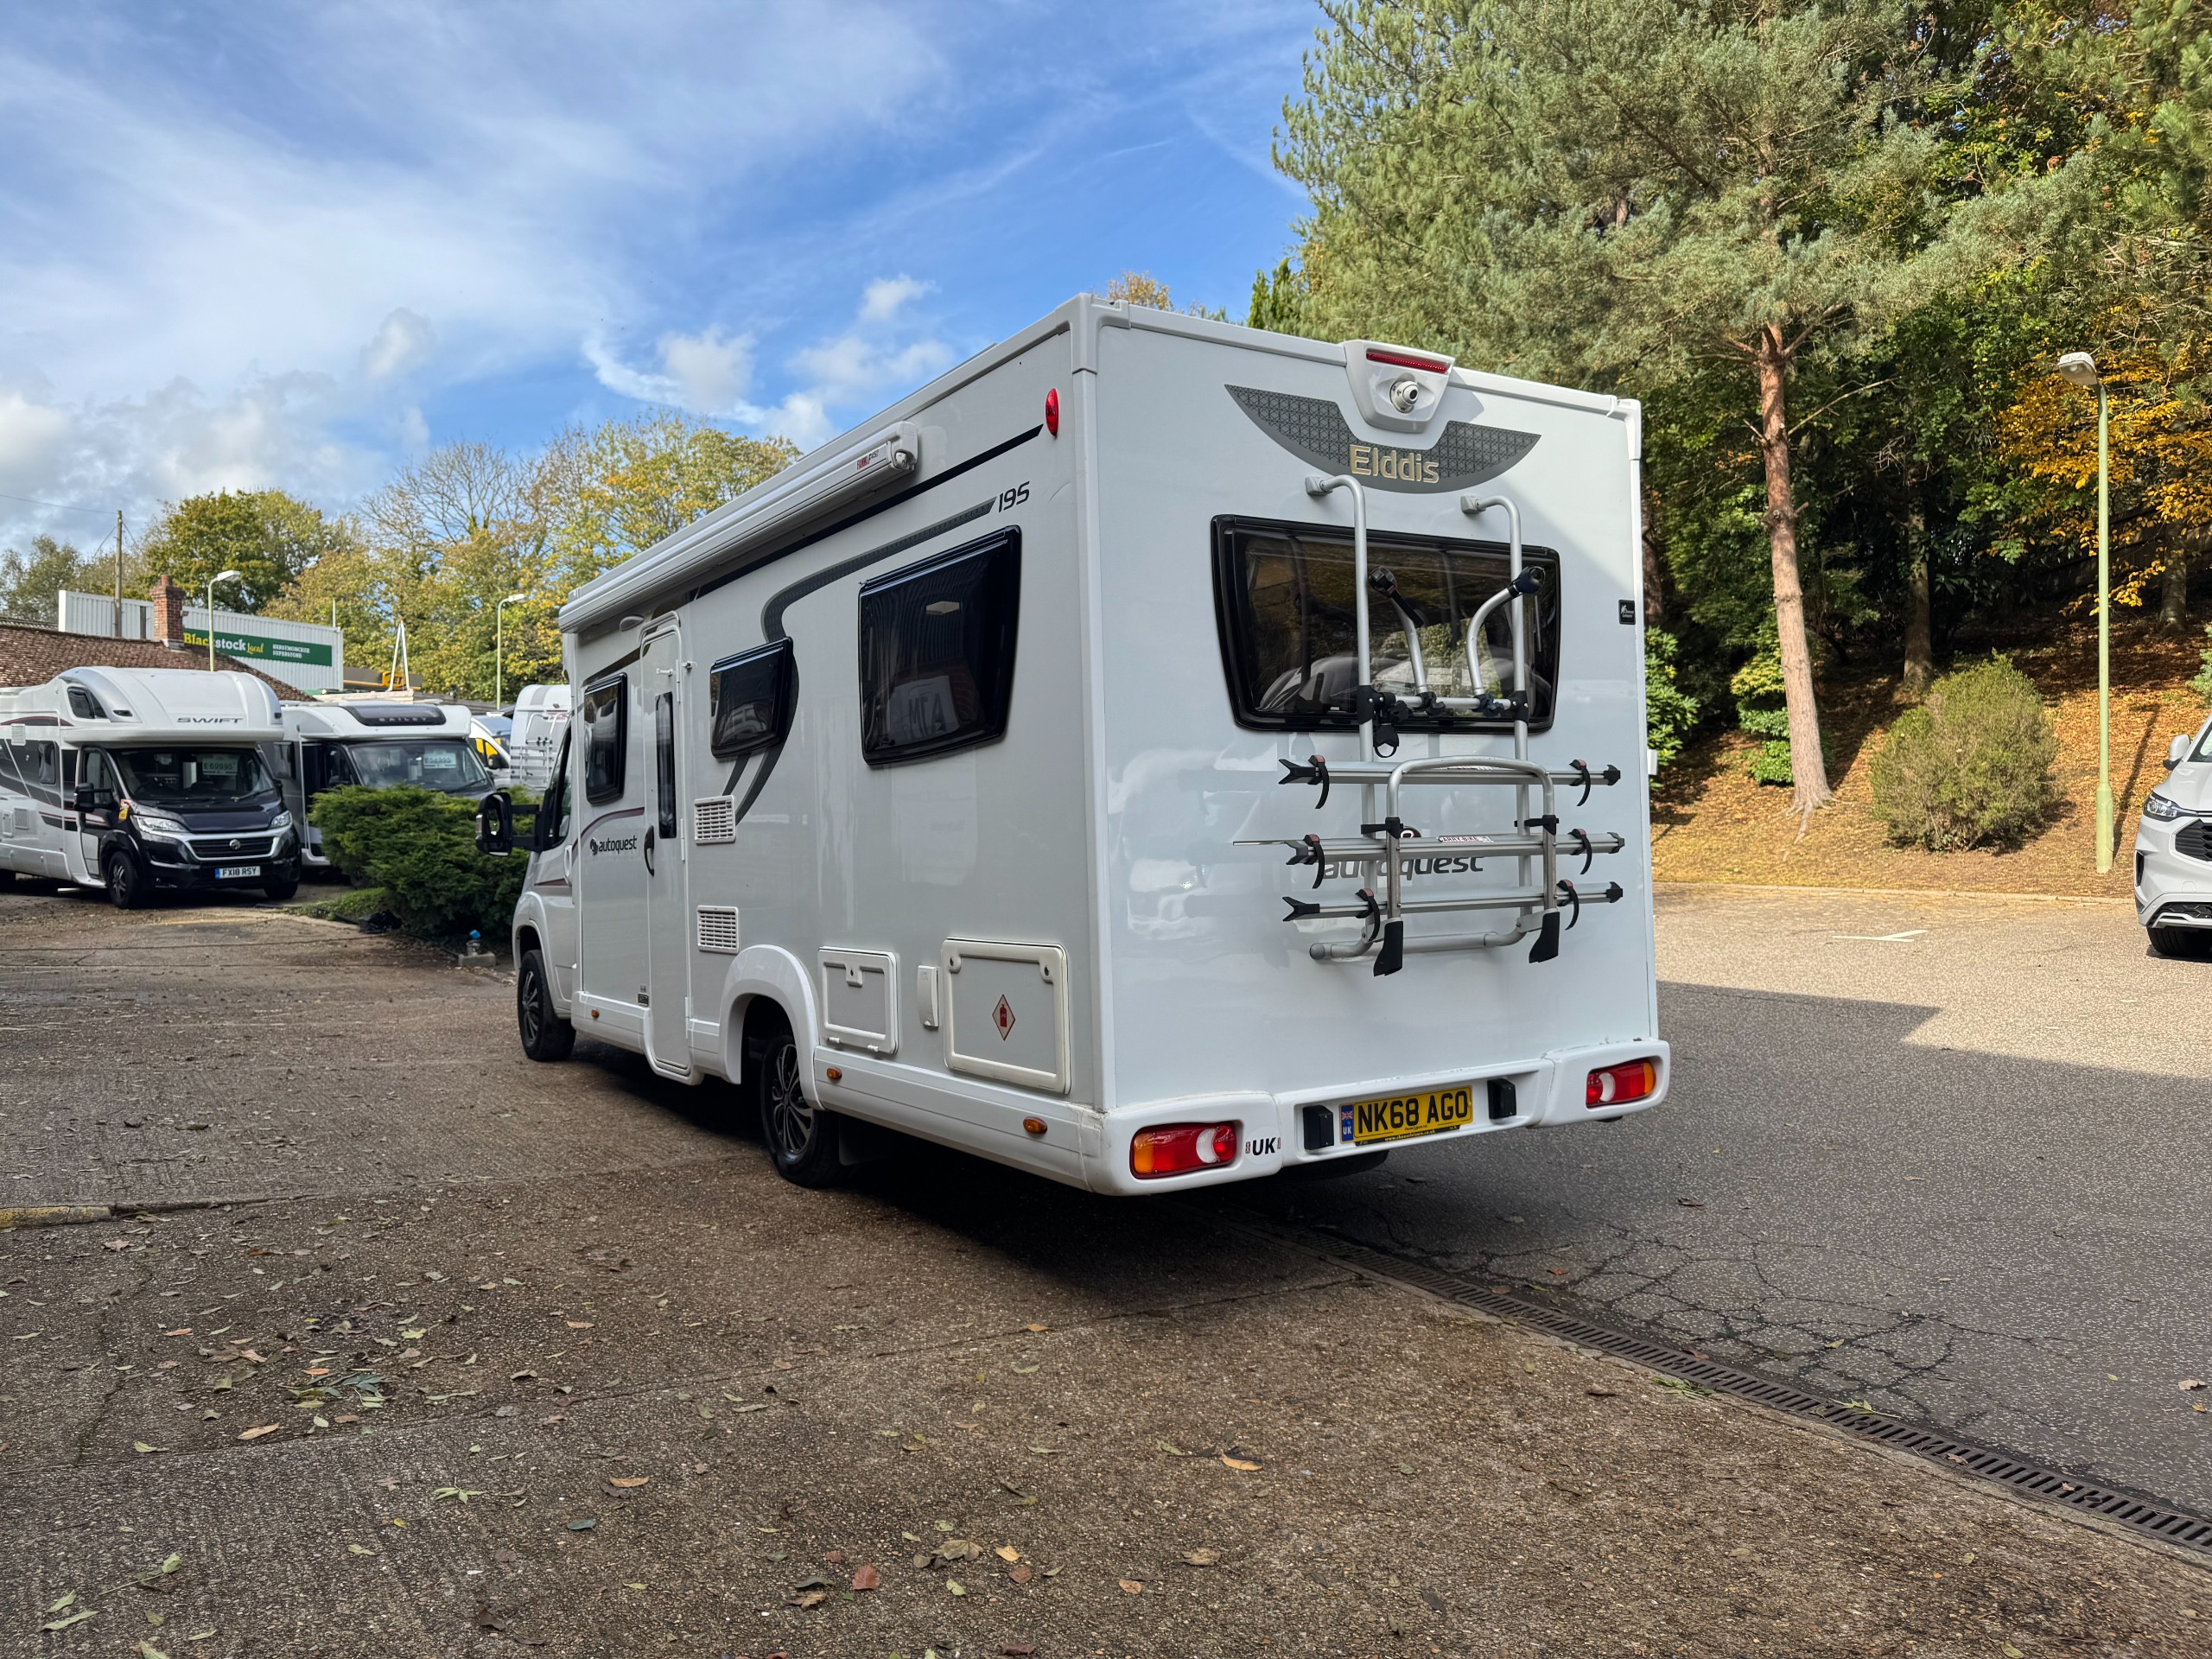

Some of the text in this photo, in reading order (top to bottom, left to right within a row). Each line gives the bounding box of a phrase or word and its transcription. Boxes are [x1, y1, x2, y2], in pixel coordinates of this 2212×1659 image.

[1350, 444, 1440, 484] Elddis
[183, 632, 246, 652] Blacstock
[598, 835, 638, 855] autoquest
[242, 867, 257, 875] RSY
[1357, 1090, 1468, 1135] NK68 AGO
[1343, 1126, 1352, 1135] UK
[1252, 1136, 1276, 1156] UK
